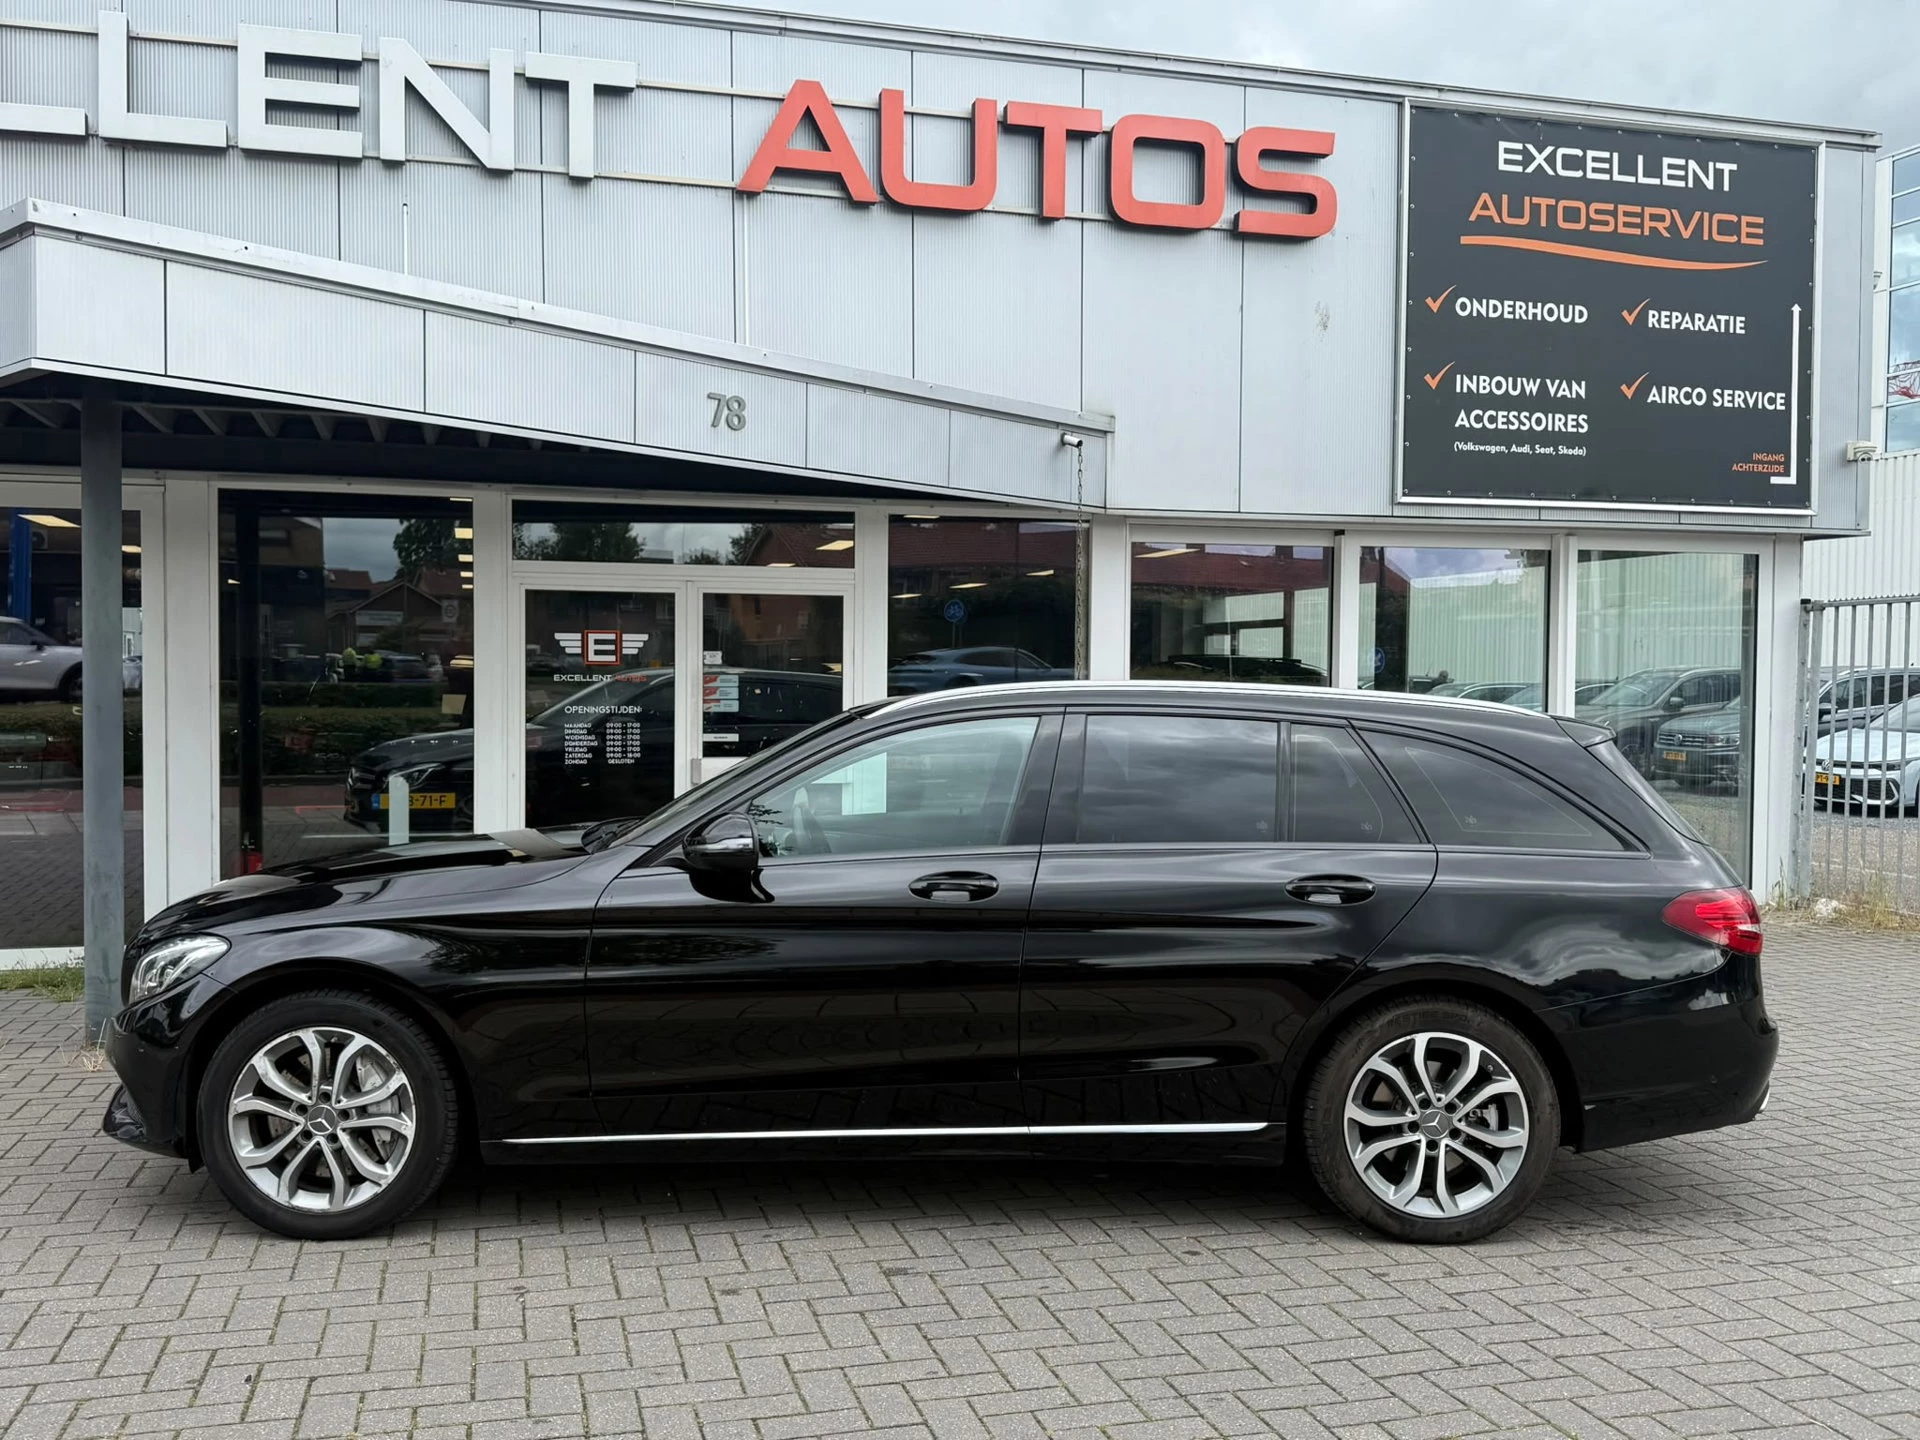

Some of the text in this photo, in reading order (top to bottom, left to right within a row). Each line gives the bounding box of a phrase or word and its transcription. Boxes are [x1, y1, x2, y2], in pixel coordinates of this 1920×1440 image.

[735, 79, 1338, 238] AUTOS
[1498, 140, 1738, 191] EXCELLENT
[1468, 192, 1765, 245] AUTOSERVICE
[1455, 297, 1588, 324] ONDERHOUD
[1648, 310, 1746, 334] REPARATIE
[1455, 374, 1586, 399] INBOUW VAN
[1647, 386, 1786, 411] AIRCO SERVICE
[706, 392, 747, 432] 78
[1454, 409, 1589, 433] ACCESSOIRES
[1453, 441, 1587, 457] (Volkswagen, Audi, Seat, Skoda)
[1752, 452, 1785, 462] INGANG
[1731, 463, 1785, 473] ACHTERZIJDE
[587, 633, 616, 662] E
[553, 674, 613, 682] EXCELLENT
[564, 705, 643, 714] OPENINGSTIJDEN:
